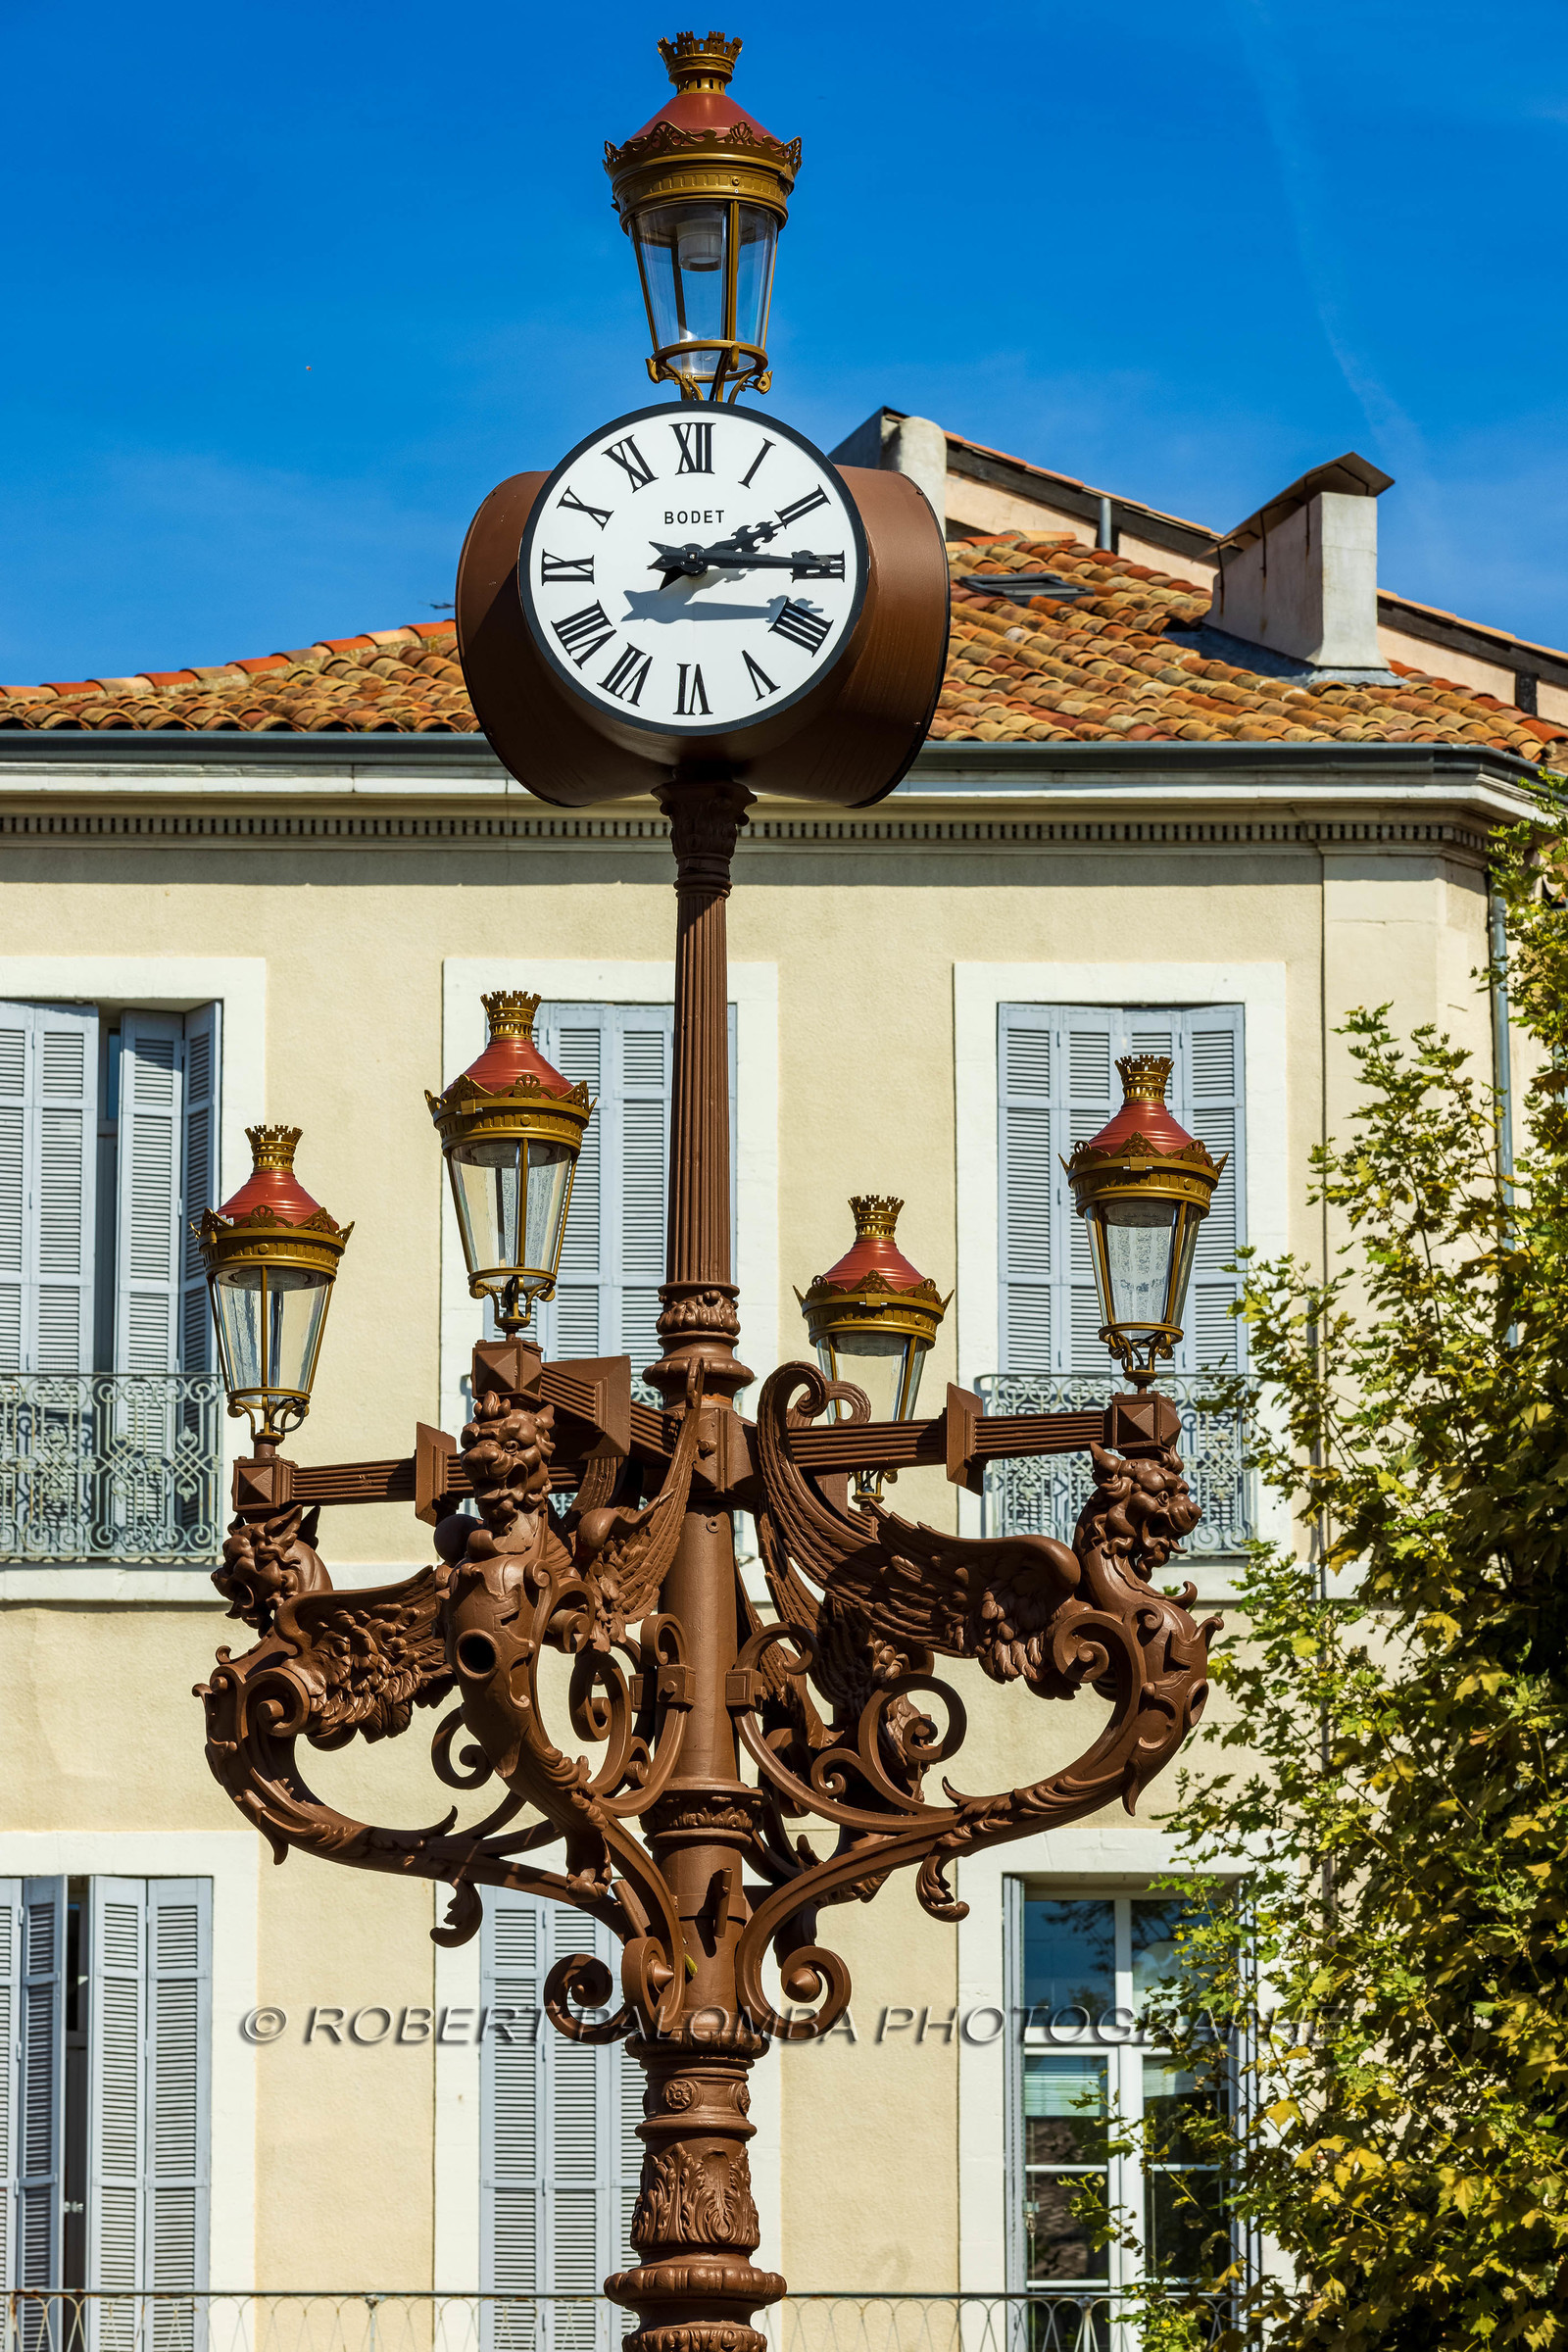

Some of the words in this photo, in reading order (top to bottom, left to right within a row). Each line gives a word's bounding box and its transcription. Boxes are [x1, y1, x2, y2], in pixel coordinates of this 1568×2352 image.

[601, 433, 660, 494] XI
[668, 421, 716, 476] XII
[737, 437, 777, 490] I
[556, 485, 614, 531] X
[663, 510, 725, 525] BODET
[774, 483, 831, 529] II
[541, 548, 595, 587] IX
[550, 599, 617, 670] VIII
[767, 597, 834, 659] IIII
[596, 642, 654, 708] VII
[672, 662, 714, 716] VI
[741, 649, 781, 702] V
